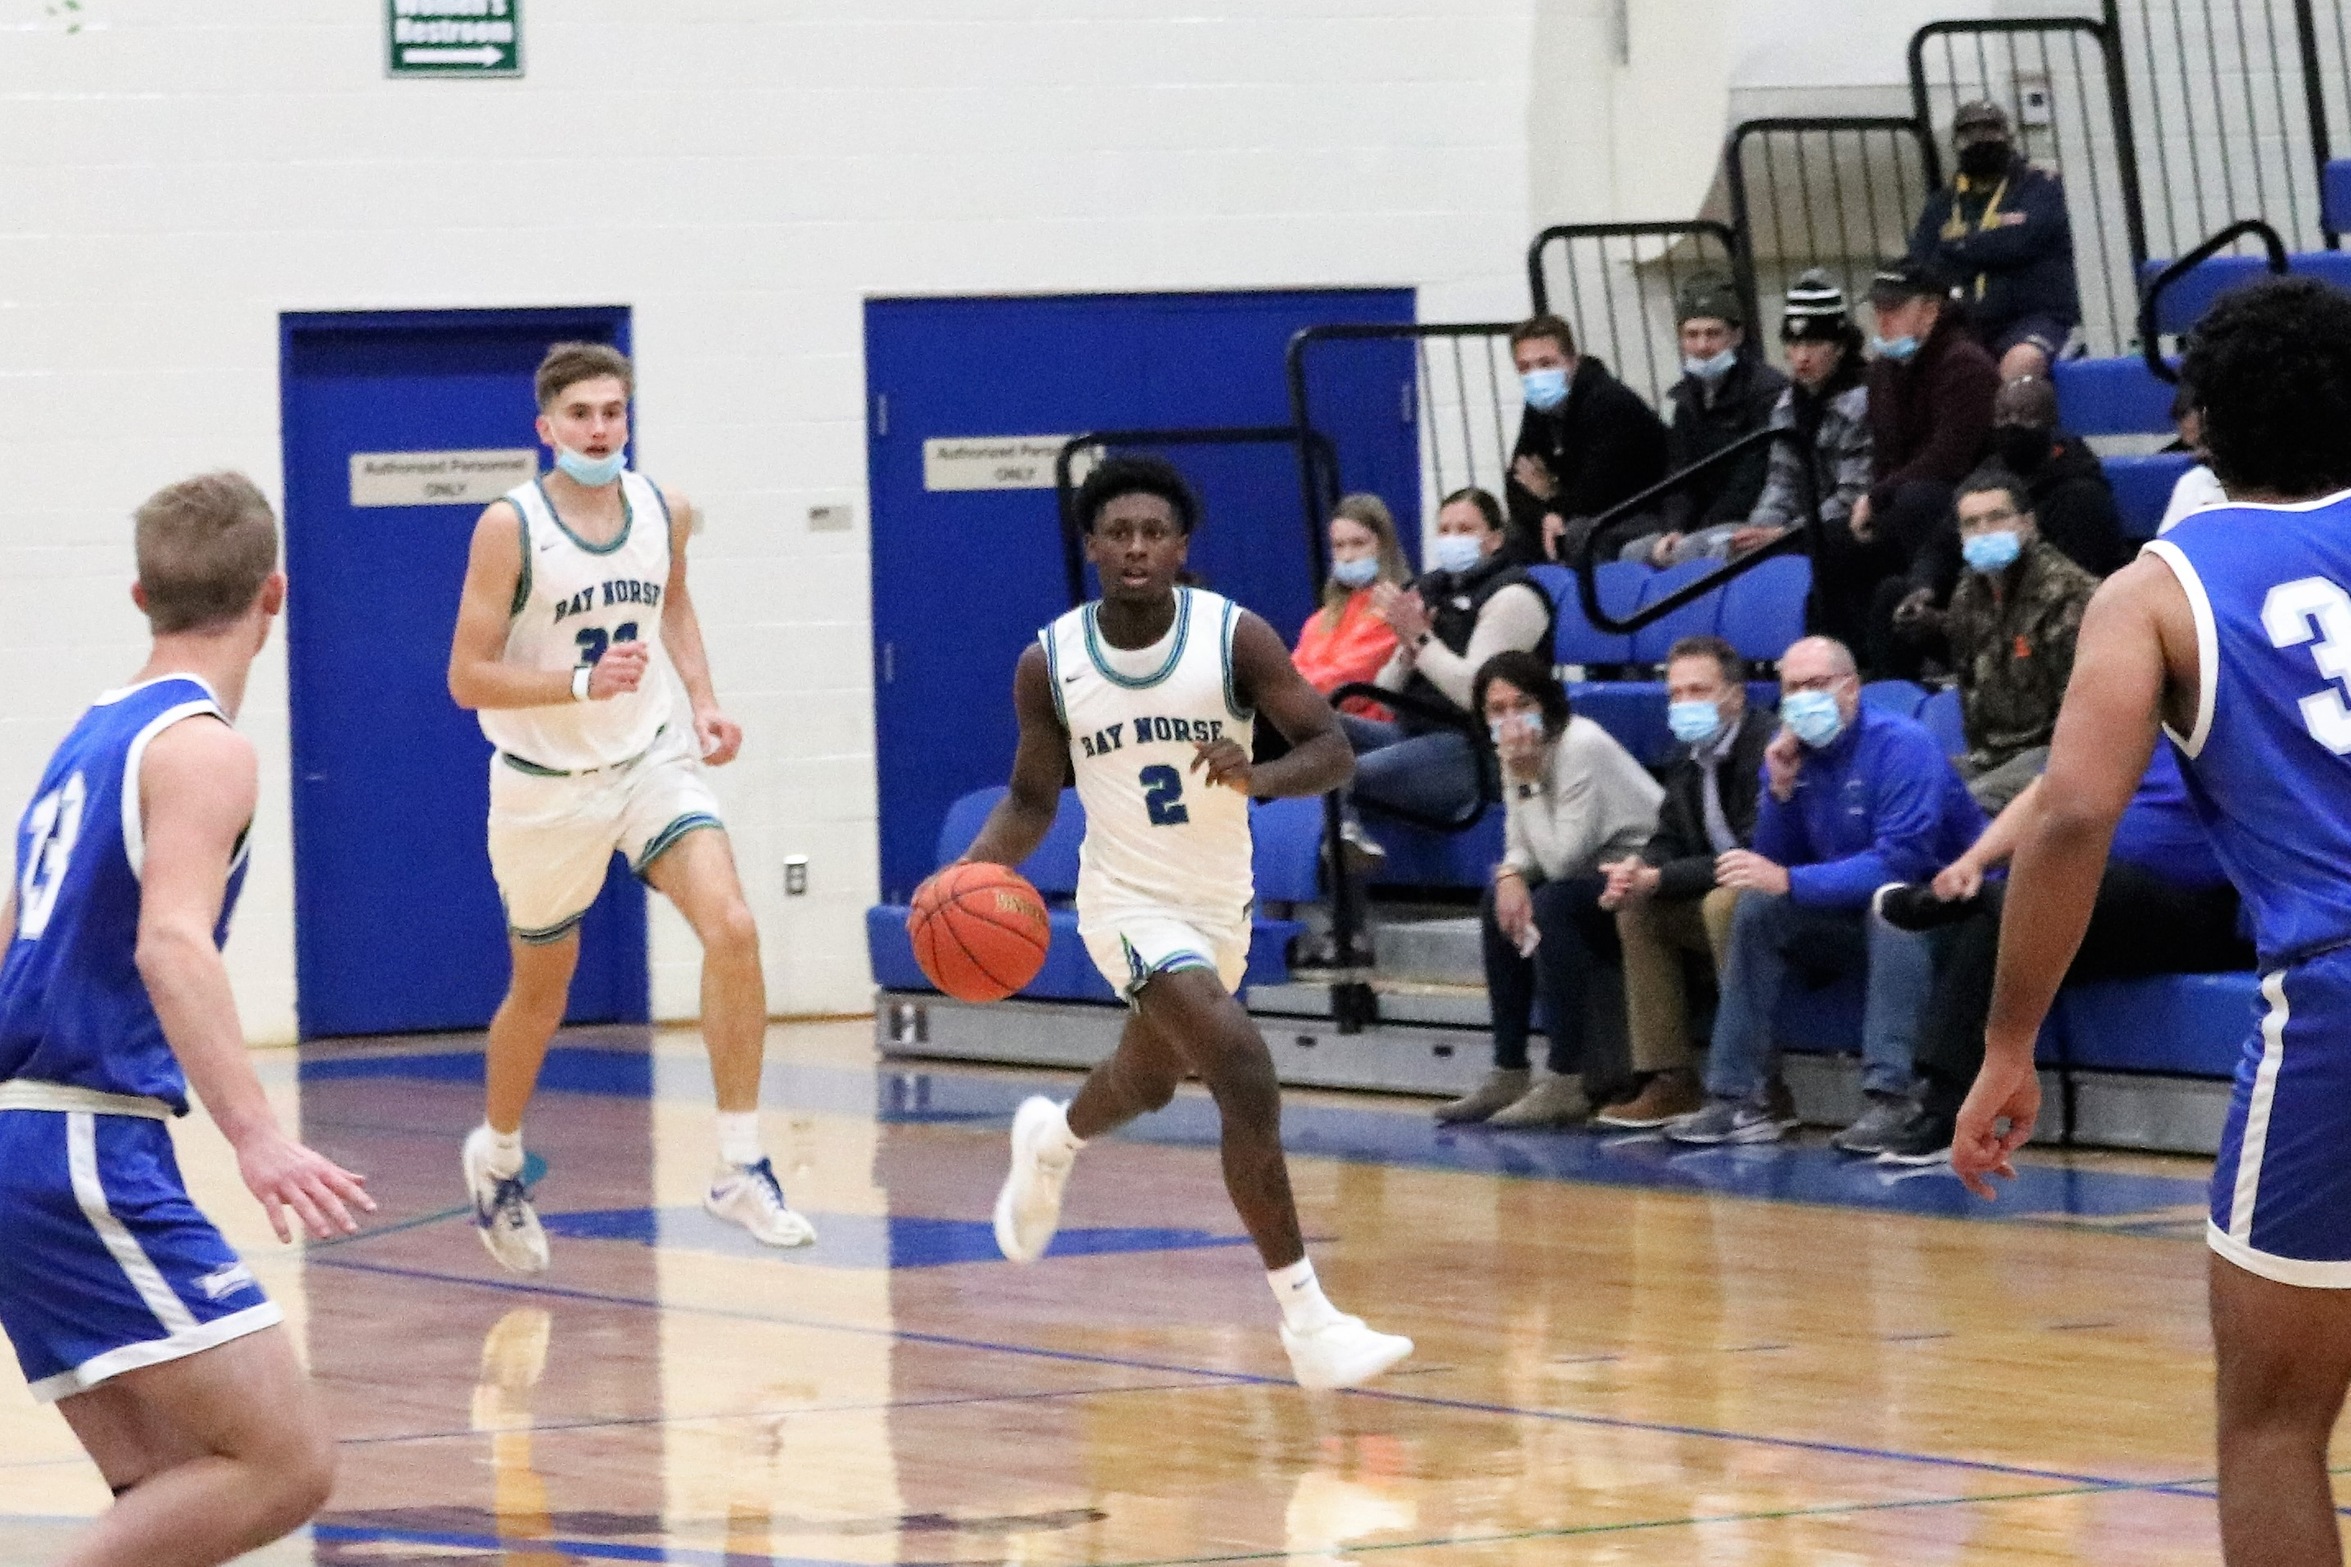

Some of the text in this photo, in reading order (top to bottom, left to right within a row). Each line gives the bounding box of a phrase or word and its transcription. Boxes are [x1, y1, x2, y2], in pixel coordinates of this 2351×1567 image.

[395, 0, 507, 16] Womens
[395, 18, 513, 43] Restroom
[451, 457, 527, 473] Personnel
[995, 466, 1036, 482] ONLY
[425, 481, 468, 497] ONLY
[1138, 763, 1190, 827] 2
